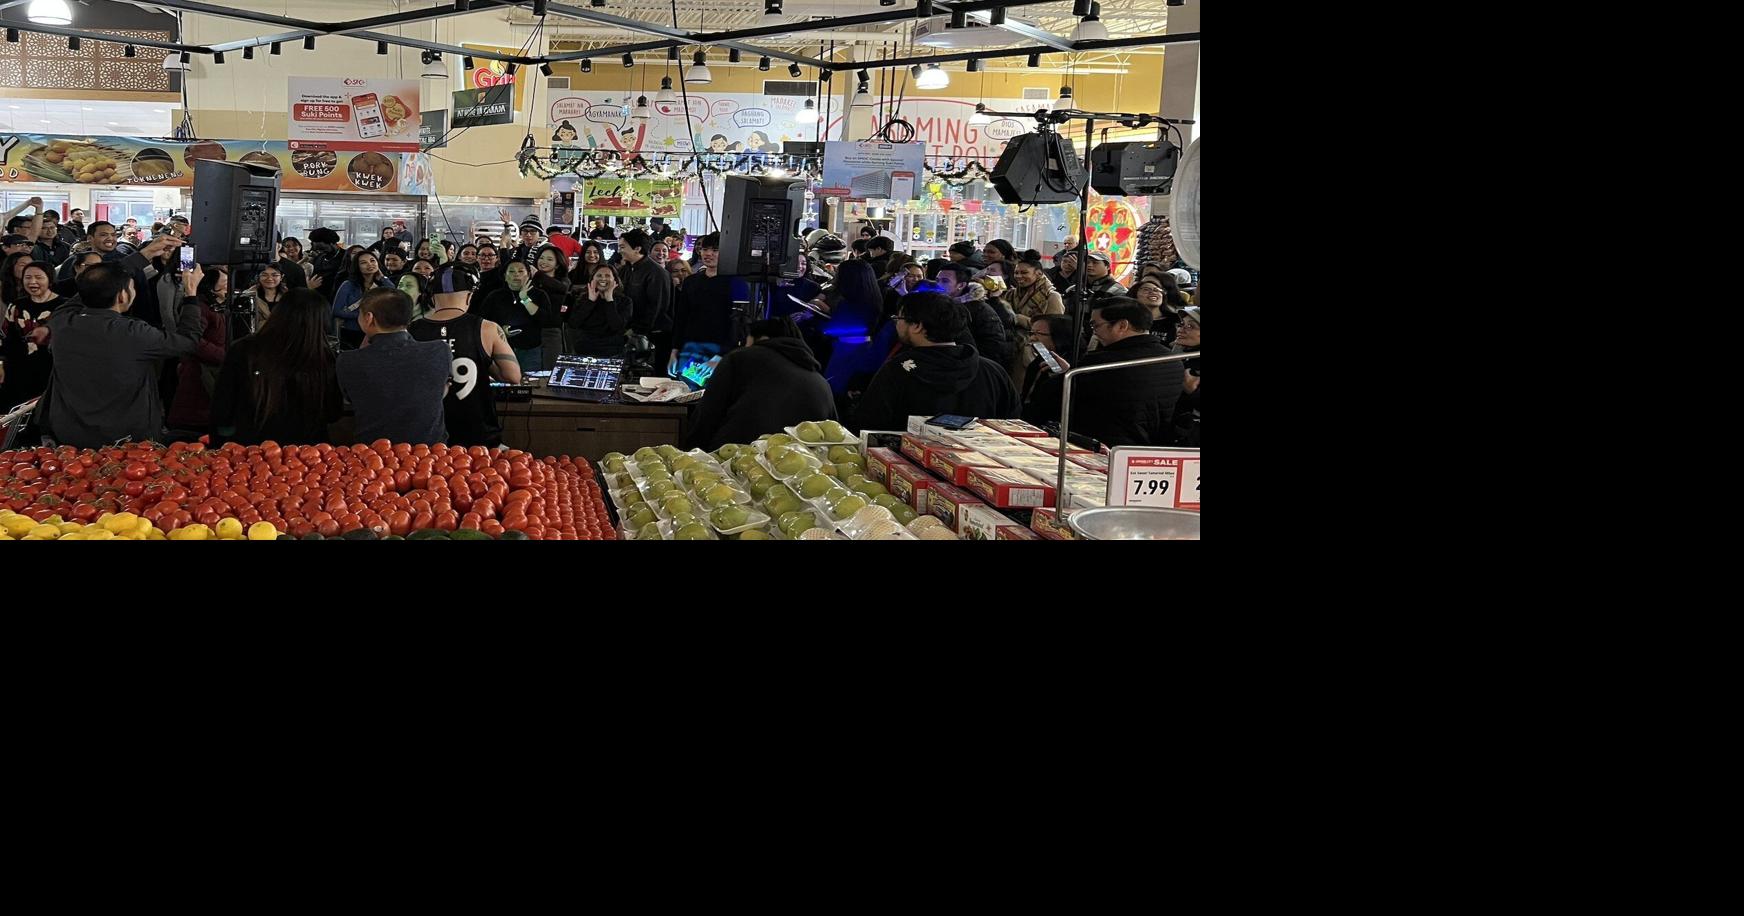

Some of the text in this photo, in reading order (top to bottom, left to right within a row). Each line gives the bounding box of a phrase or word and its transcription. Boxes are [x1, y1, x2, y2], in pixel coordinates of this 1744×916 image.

[870, 114, 978, 145] ARAMING
[303, 162, 328, 170] PORK
[354, 179, 381, 188] KWEK
[355, 172, 383, 182] KWEK
[589, 185, 642, 198] Lechn
[451, 357, 478, 401] 9
[1133, 479, 1170, 495] 7.99
